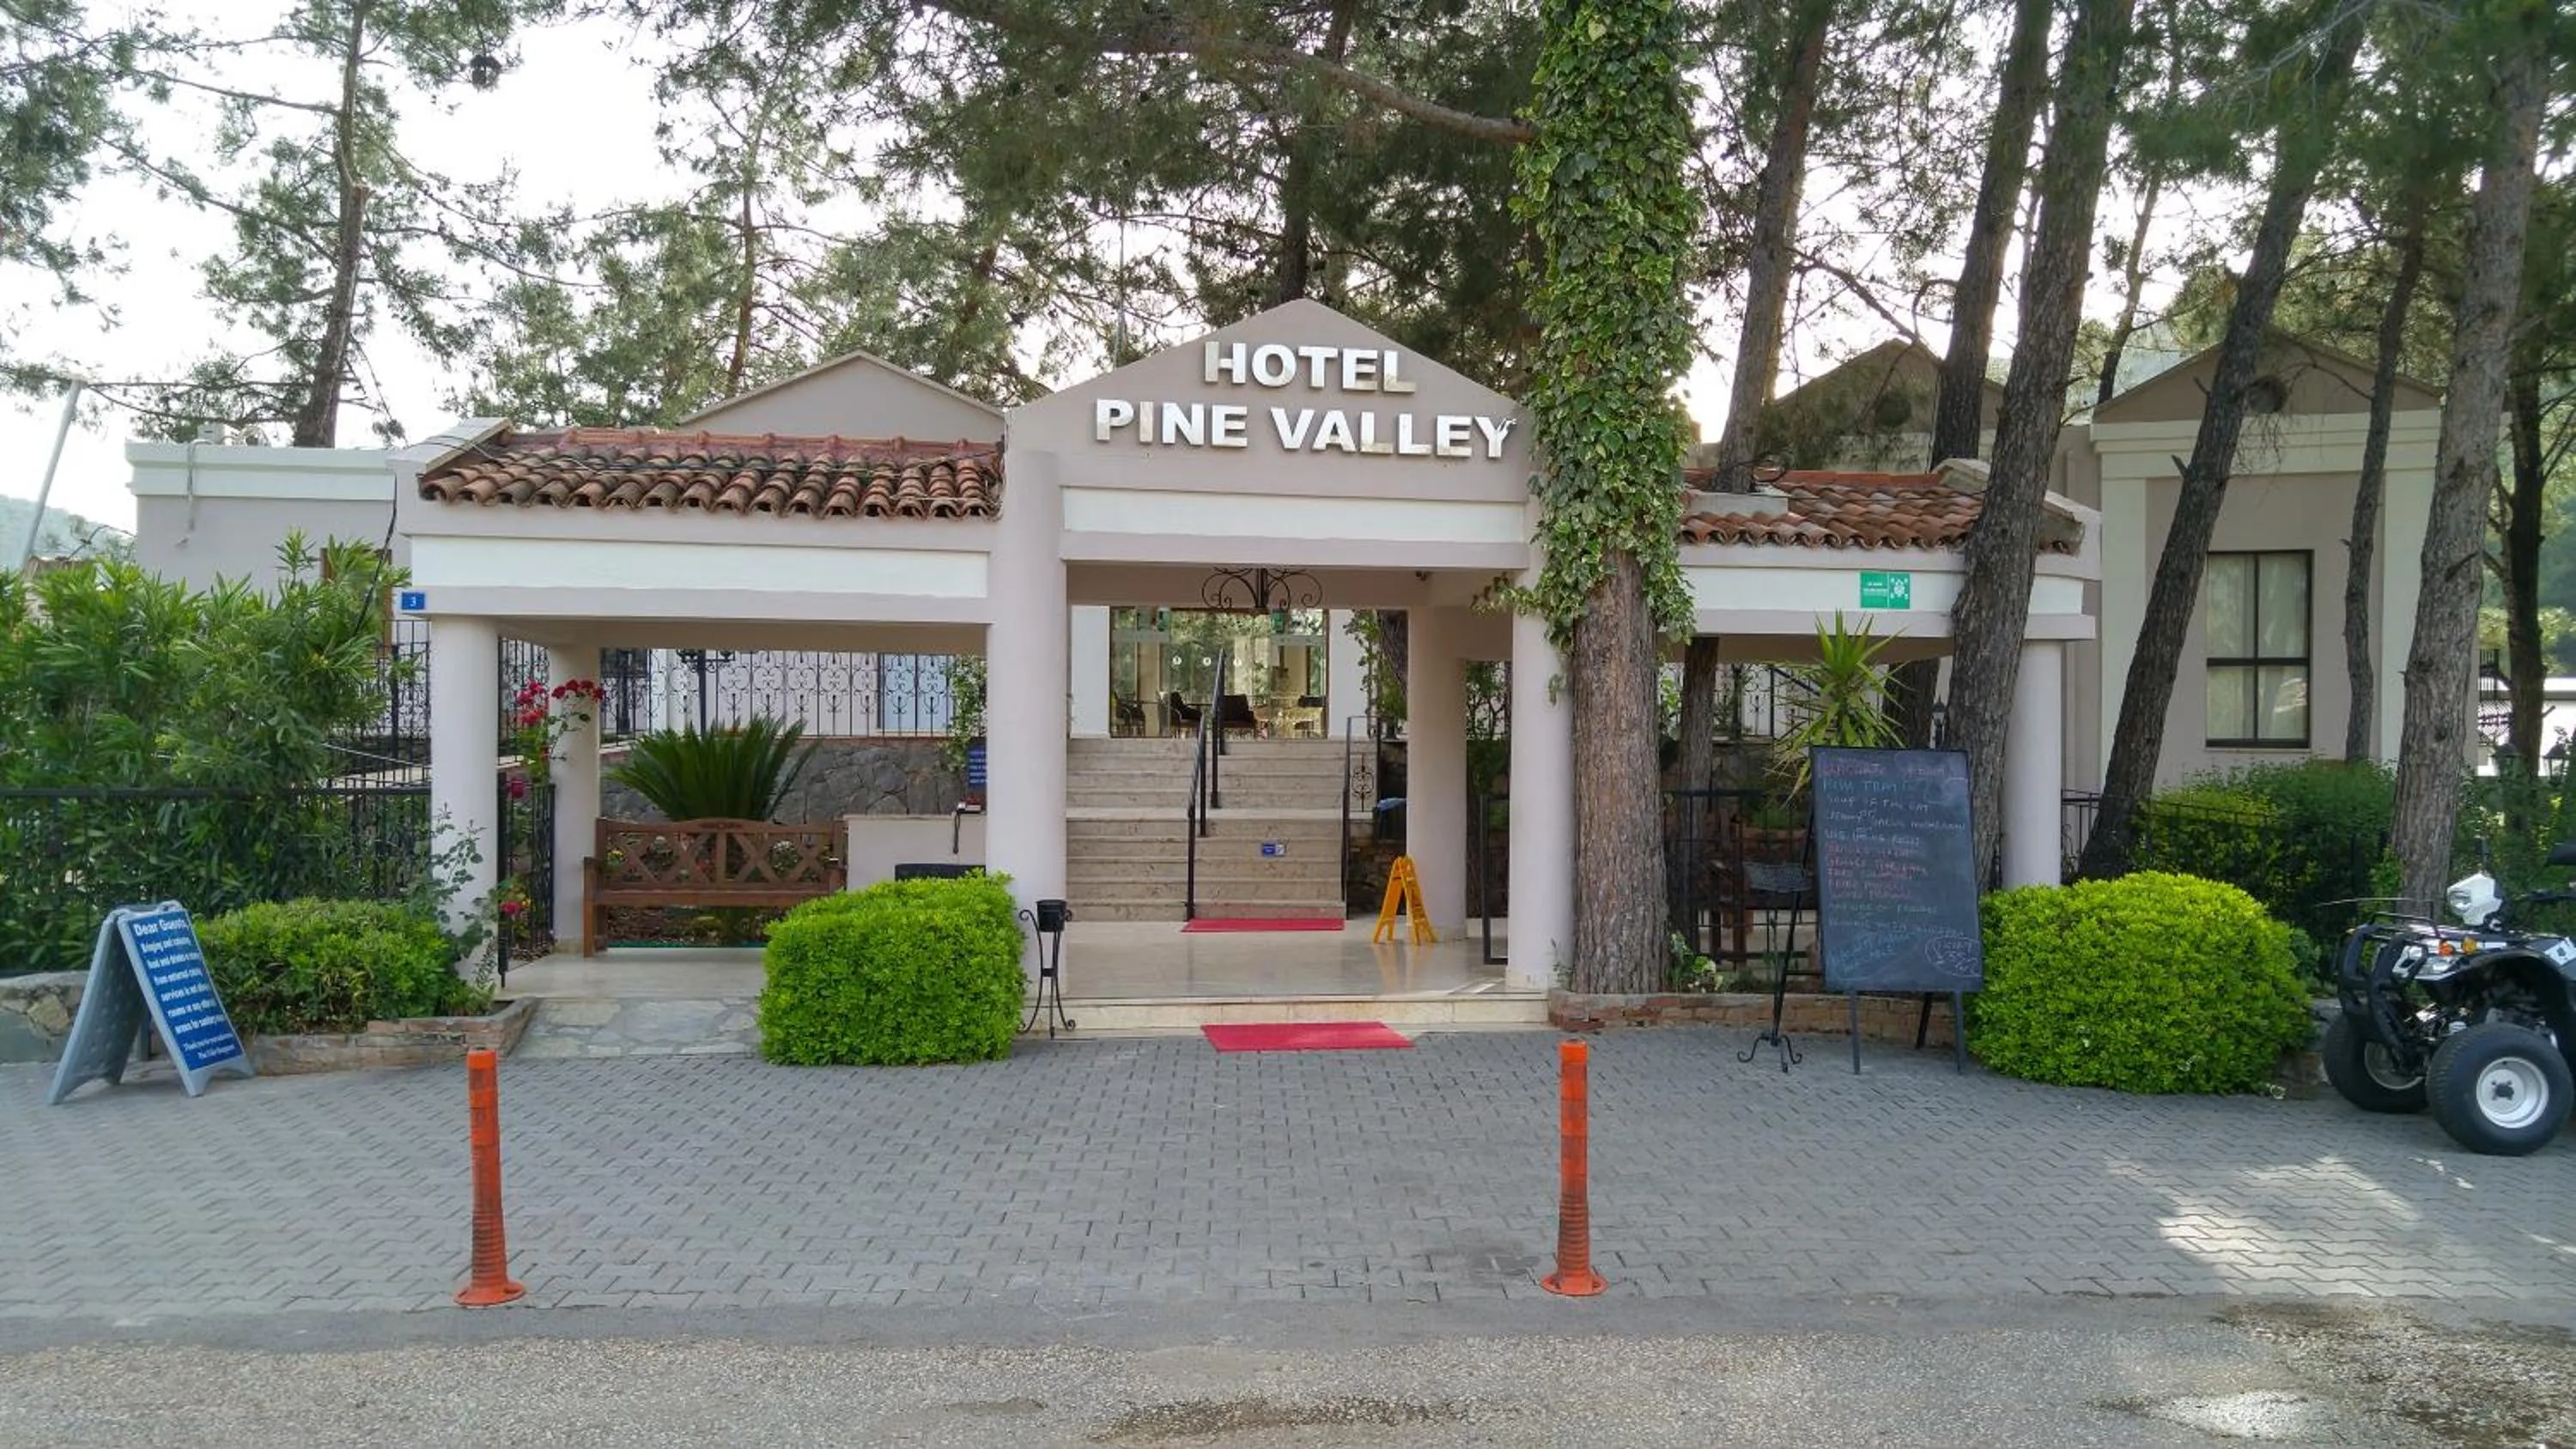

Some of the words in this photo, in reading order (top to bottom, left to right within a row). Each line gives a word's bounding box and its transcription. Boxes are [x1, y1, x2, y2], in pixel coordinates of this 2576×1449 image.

[1204, 342, 1416, 393] HOTEL
[1096, 398, 1248, 448] PINE
[1271, 406, 1517, 458] VALLEY
[133, 923, 159, 937] Dear
